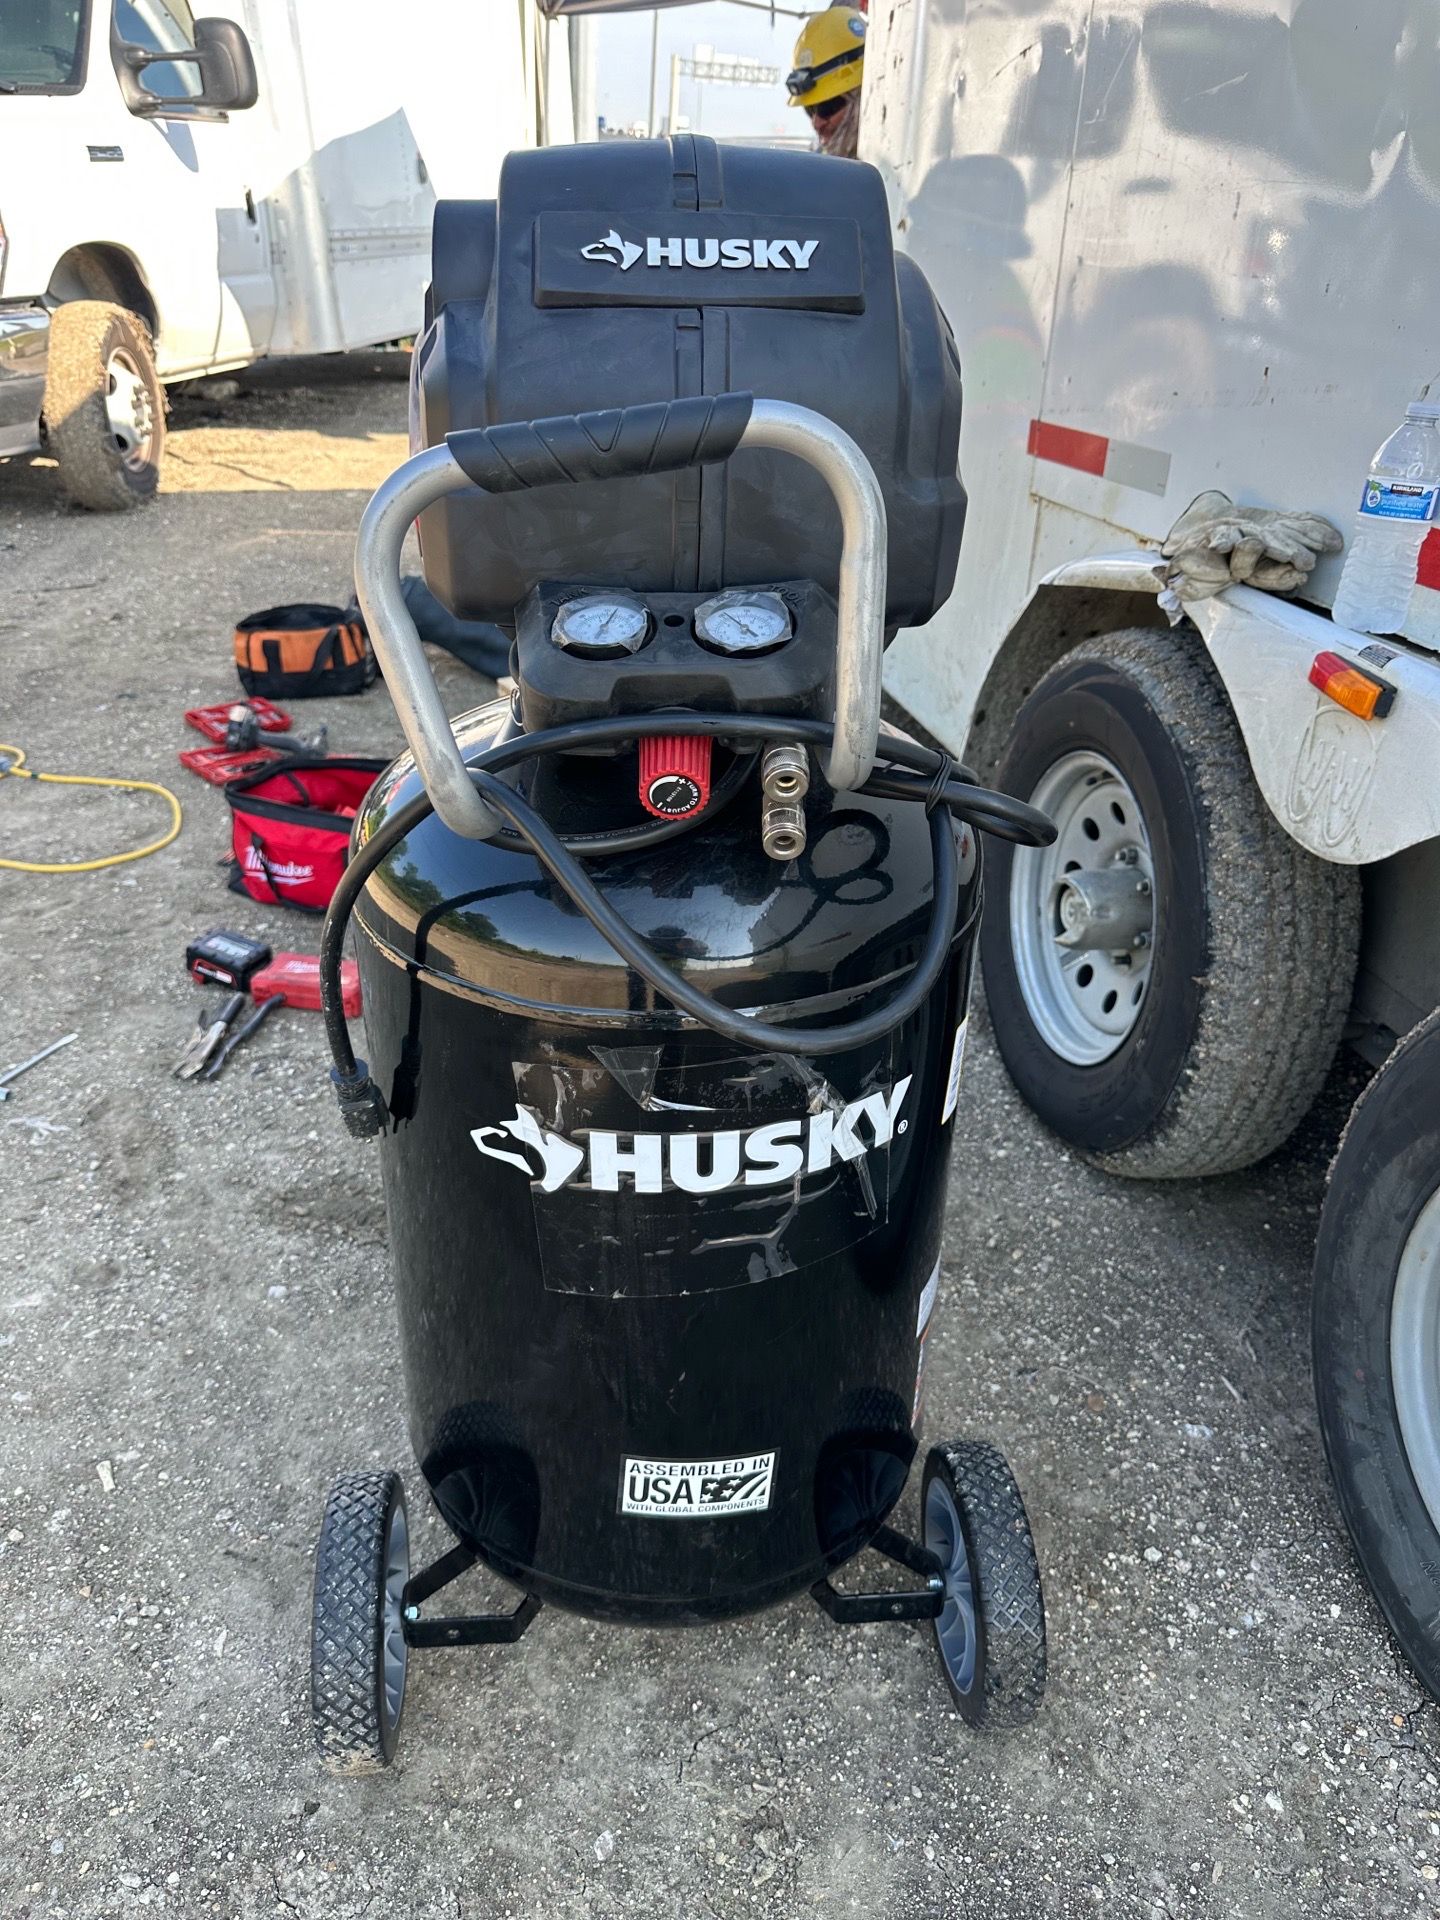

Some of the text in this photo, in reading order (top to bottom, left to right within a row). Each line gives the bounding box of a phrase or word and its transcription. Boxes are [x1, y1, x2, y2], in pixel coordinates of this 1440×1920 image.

[646, 237, 820, 269] HUSKY
[1391, 485, 1423, 493] KIRKLAND
[686, 781, 699, 797] TURN
[661, 803, 691, 814] ADJUST
[689, 797, 698, 806] TO
[629, 1456, 771, 1477] ASSEMBLED IN
[628, 1475, 694, 1505] USA
[626, 1498, 765, 1514] WITH GLOBAL COMPONENTS
